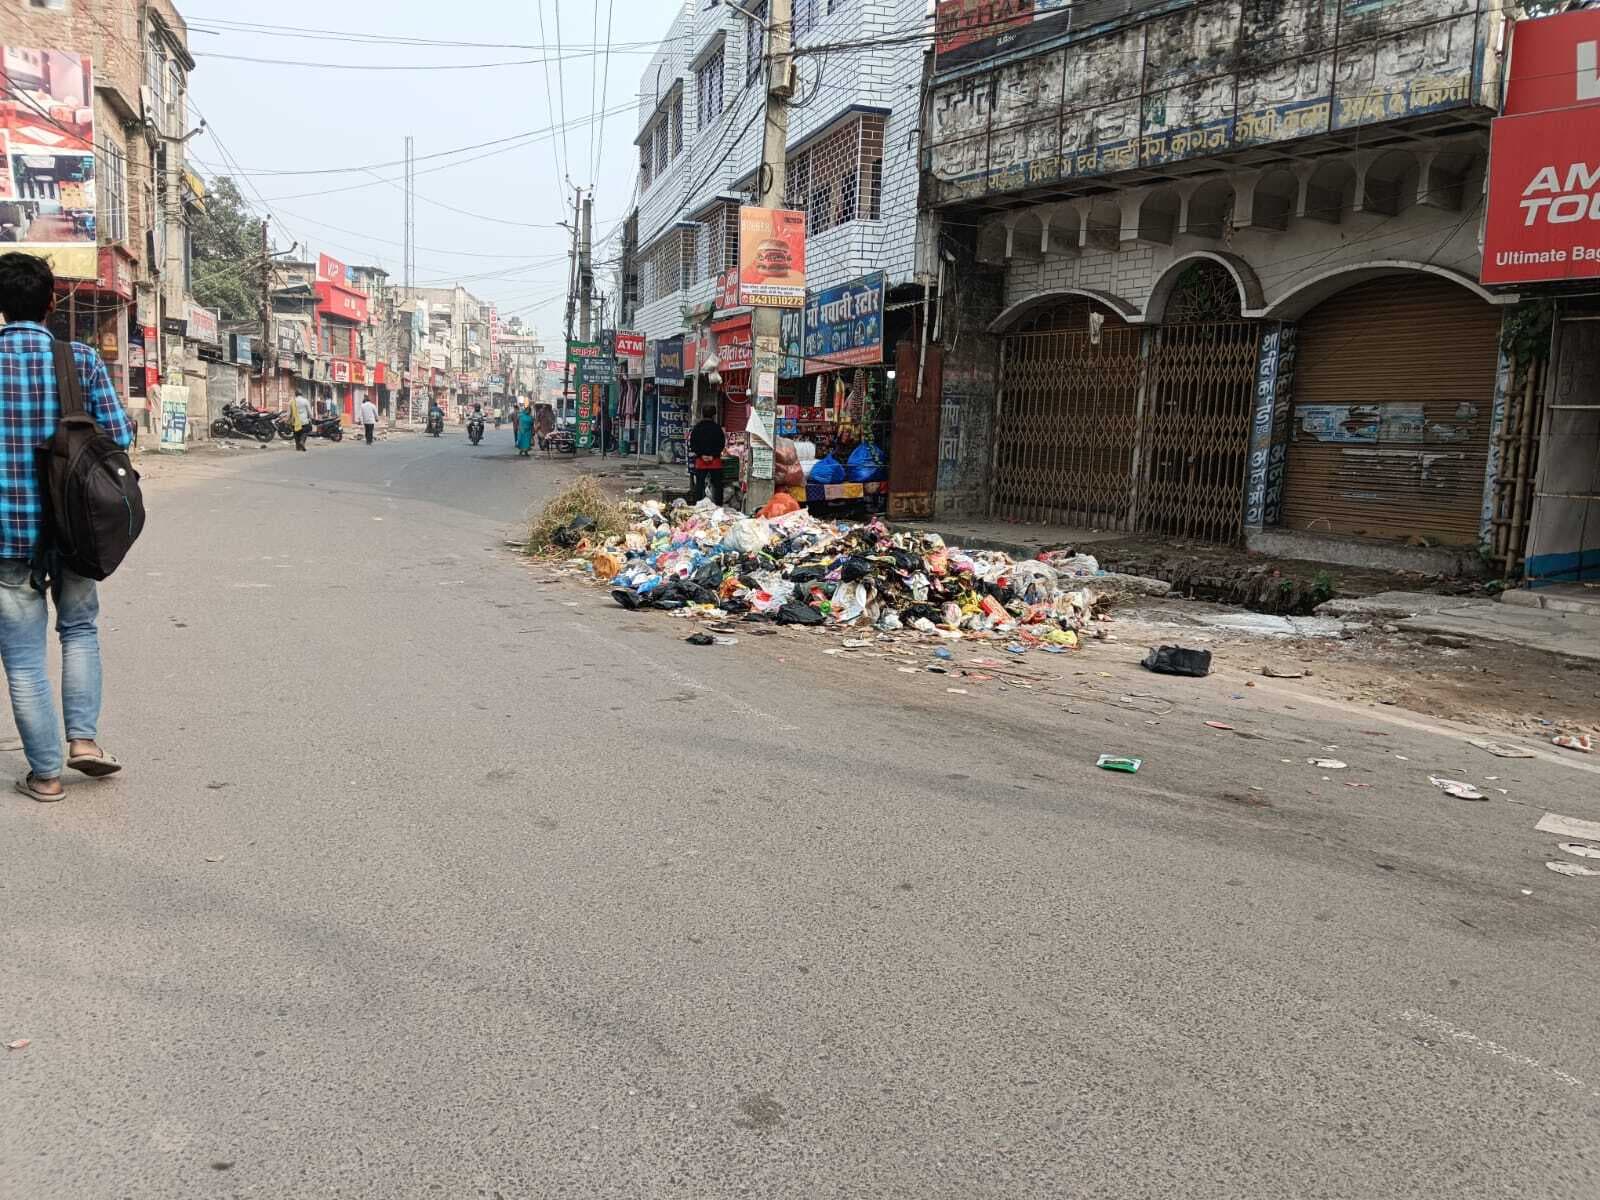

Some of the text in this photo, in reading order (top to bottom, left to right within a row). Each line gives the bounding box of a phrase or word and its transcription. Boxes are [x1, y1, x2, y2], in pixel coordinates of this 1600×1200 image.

[1522, 162, 1600, 197] AM
[1496, 247, 1567, 266] Ultimate
[820, 291, 853, 325] भवानी
[855, 284, 880, 316] स्टोर
[617, 339, 642, 352] ATM
